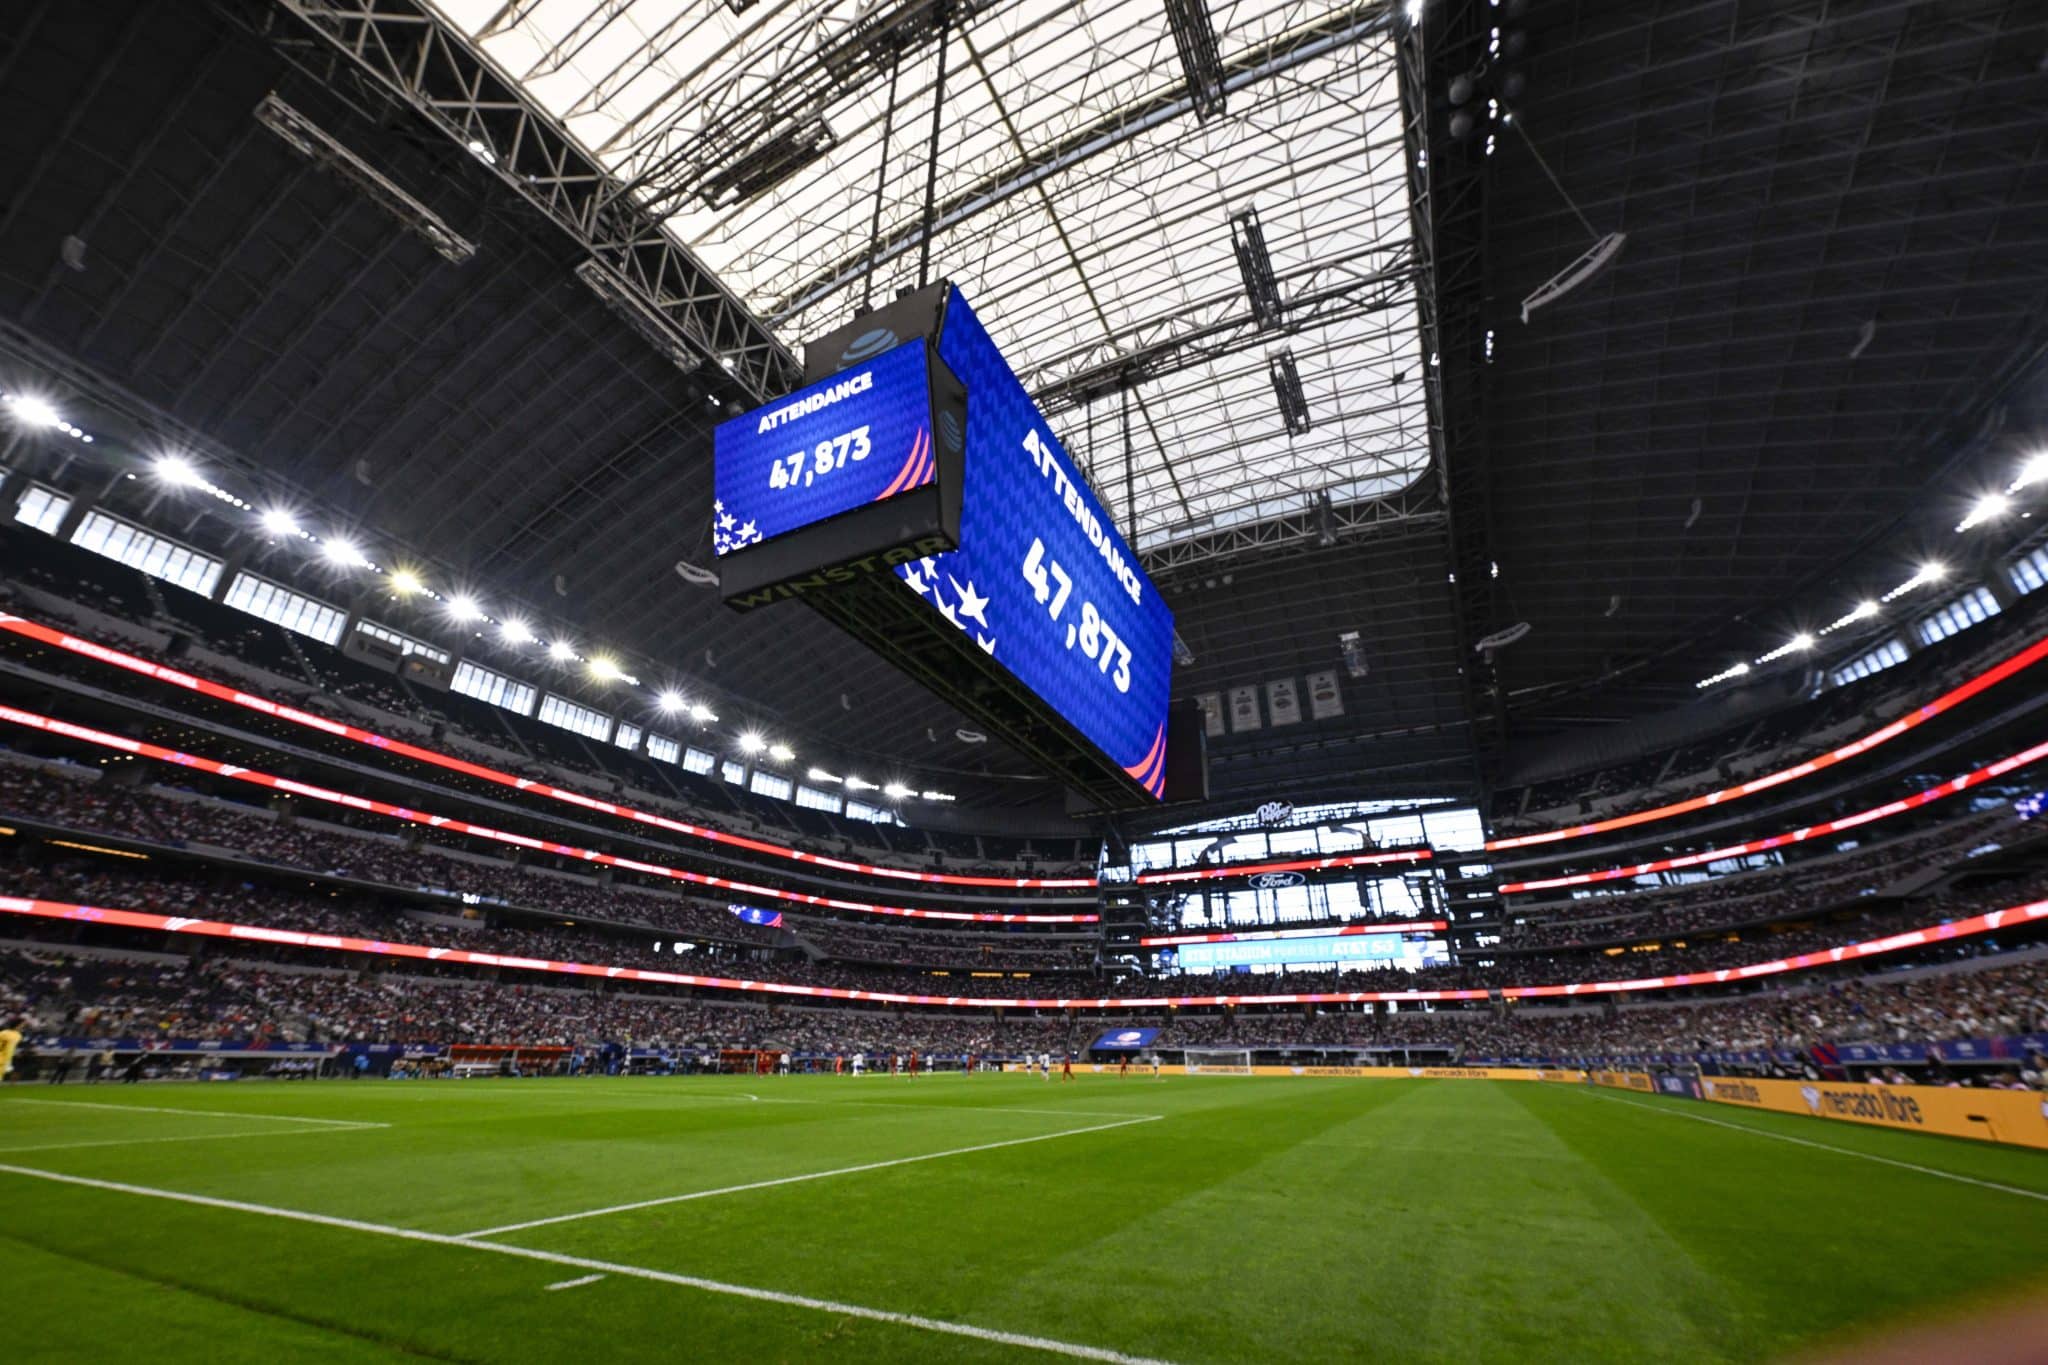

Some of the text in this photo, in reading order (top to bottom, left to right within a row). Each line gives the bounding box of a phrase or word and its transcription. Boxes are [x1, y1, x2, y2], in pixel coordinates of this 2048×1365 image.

[758, 371, 873, 434] ATTENDANCE
[769, 425, 871, 489] 47,873
[1022, 428, 1142, 605] ATTENDANCE
[733, 537, 949, 608] WINSTAR
[1023, 537, 1132, 694] 47,873
[1260, 874, 1294, 888] Ford
[1216, 945, 1271, 960] STADIUM
[1331, 941, 1367, 954] AT&T
[1823, 1088, 1923, 1124] mercado libre
